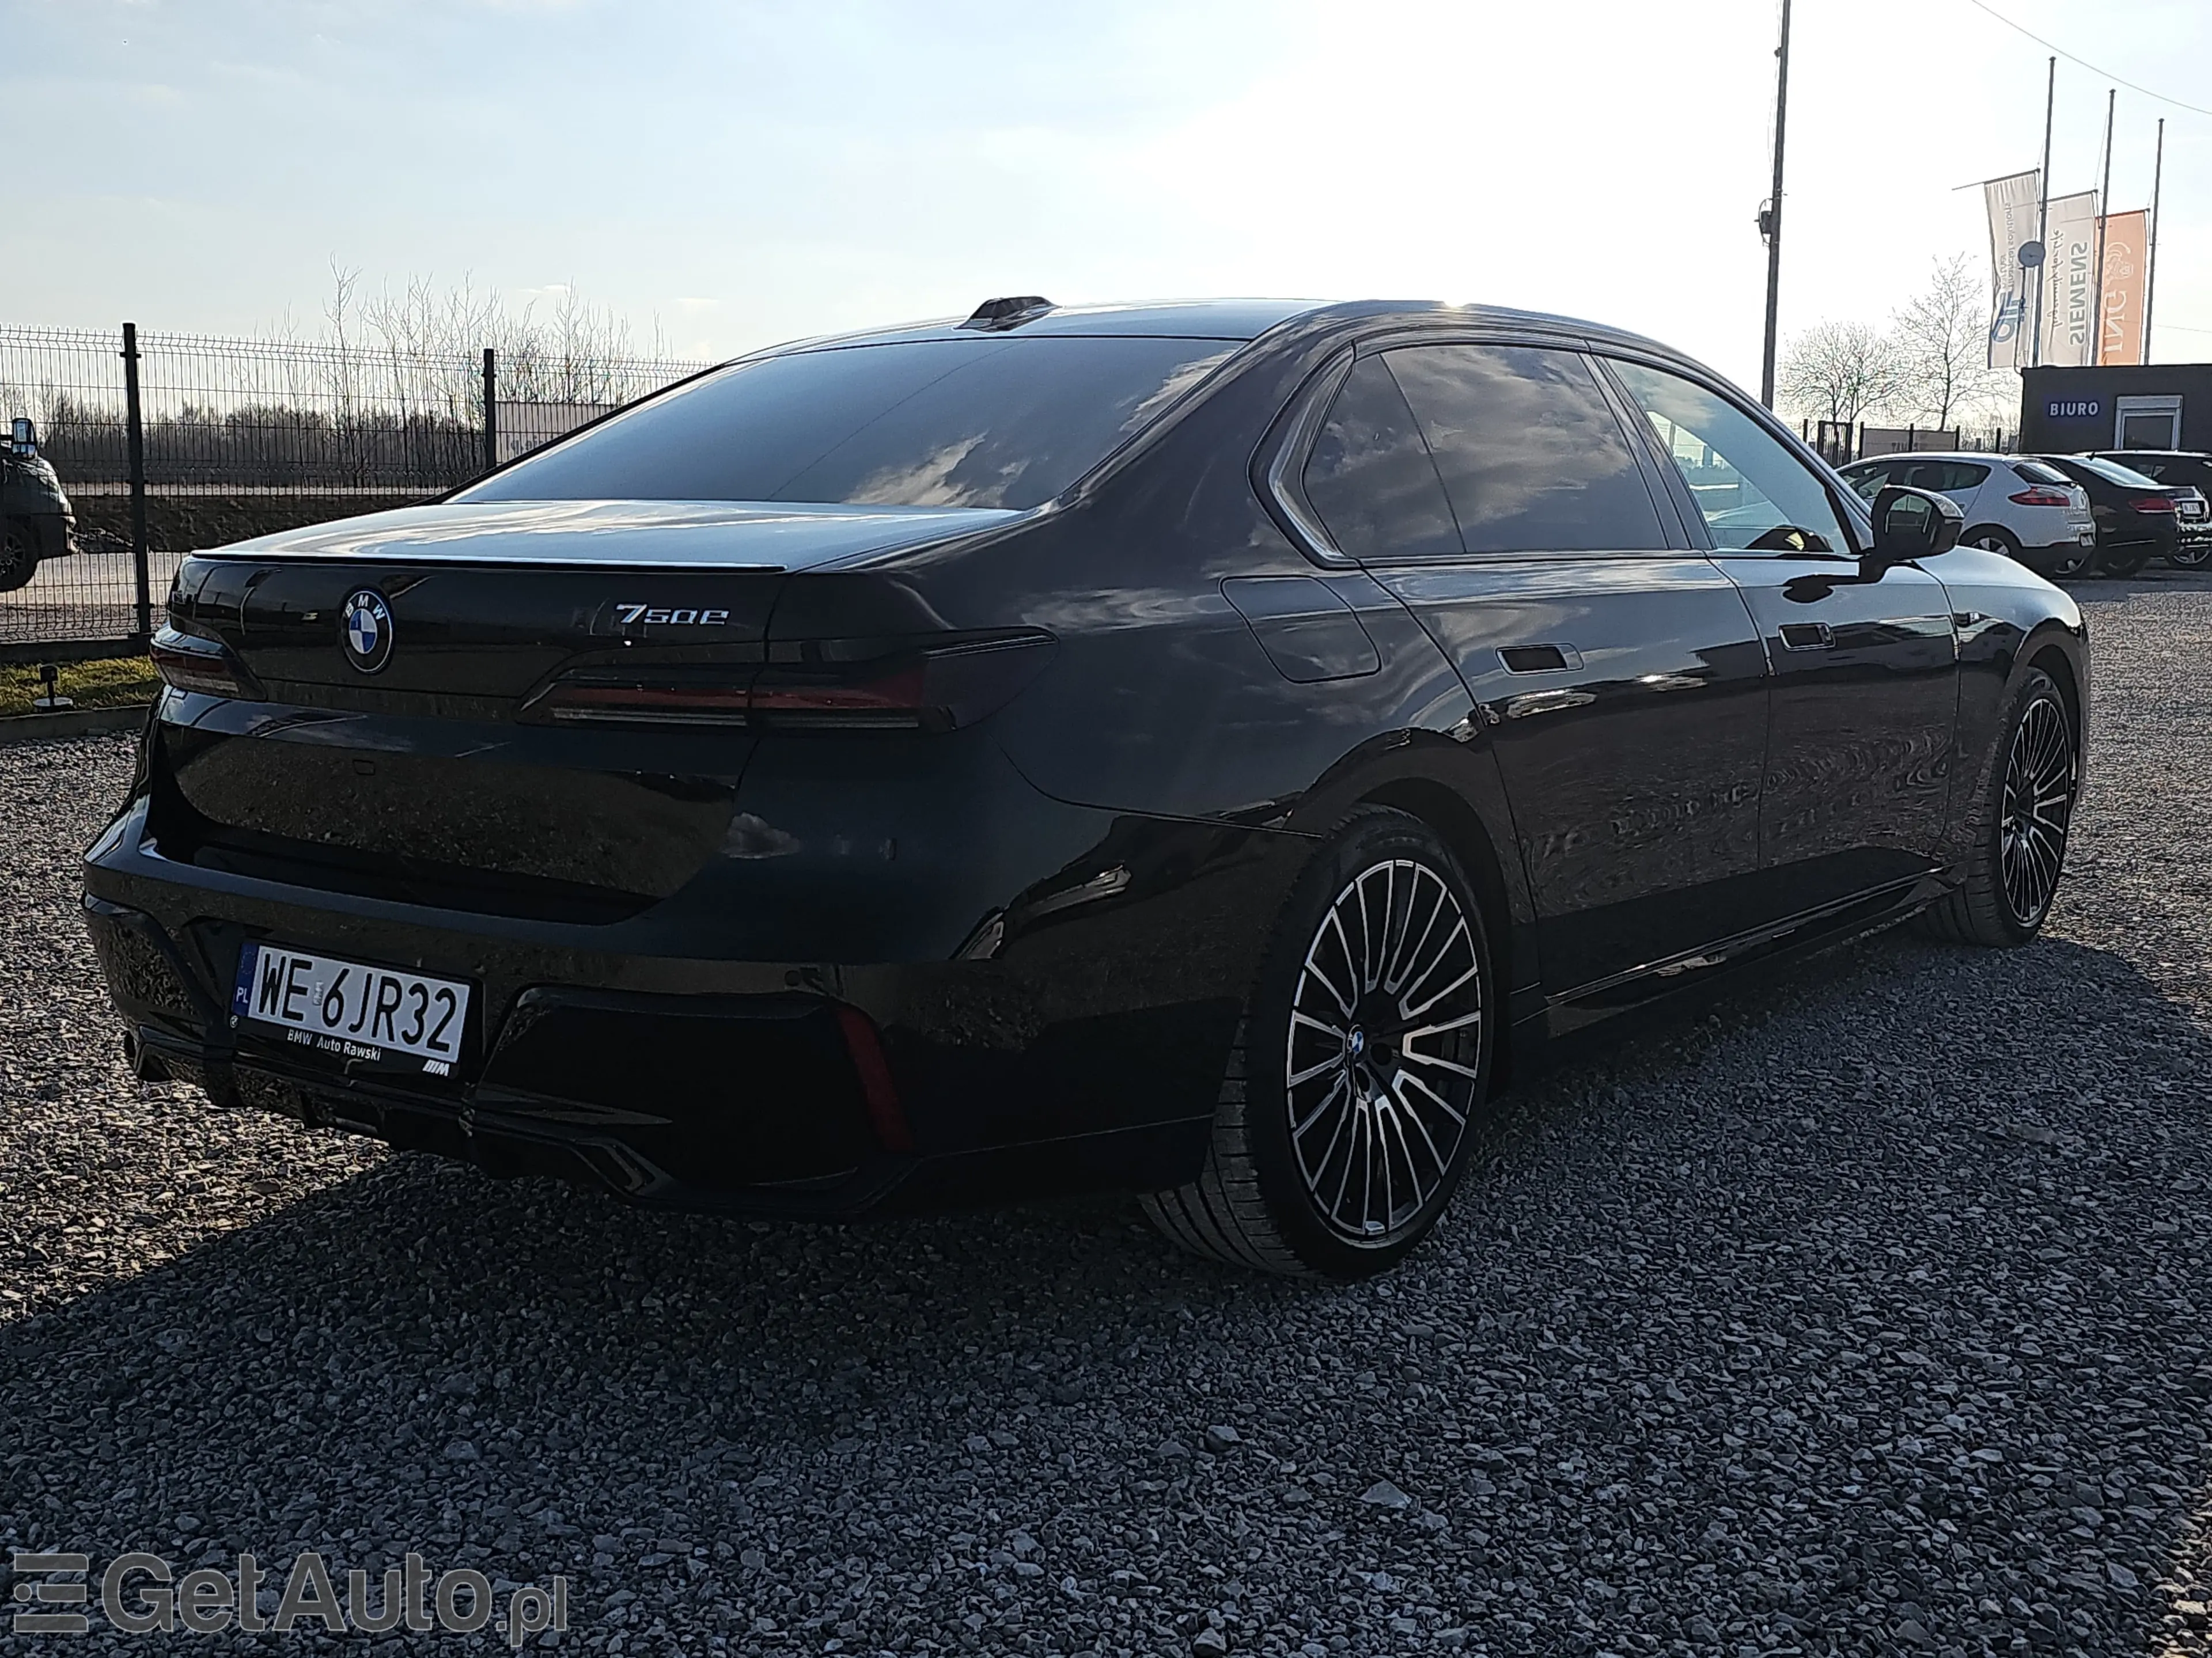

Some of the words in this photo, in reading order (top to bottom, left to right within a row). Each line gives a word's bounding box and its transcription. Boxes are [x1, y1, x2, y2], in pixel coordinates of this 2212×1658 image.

[2049, 401, 2099, 416] BIURO
[345, 594, 386, 620] BMW
[236, 986, 249, 1004] PL
[258, 953, 312, 1022] WE
[322, 968, 457, 1053] 6JR32
[287, 1029, 313, 1046] BMW
[316, 1035, 341, 1052] Auto
[343, 1041, 381, 1061] Rawski
